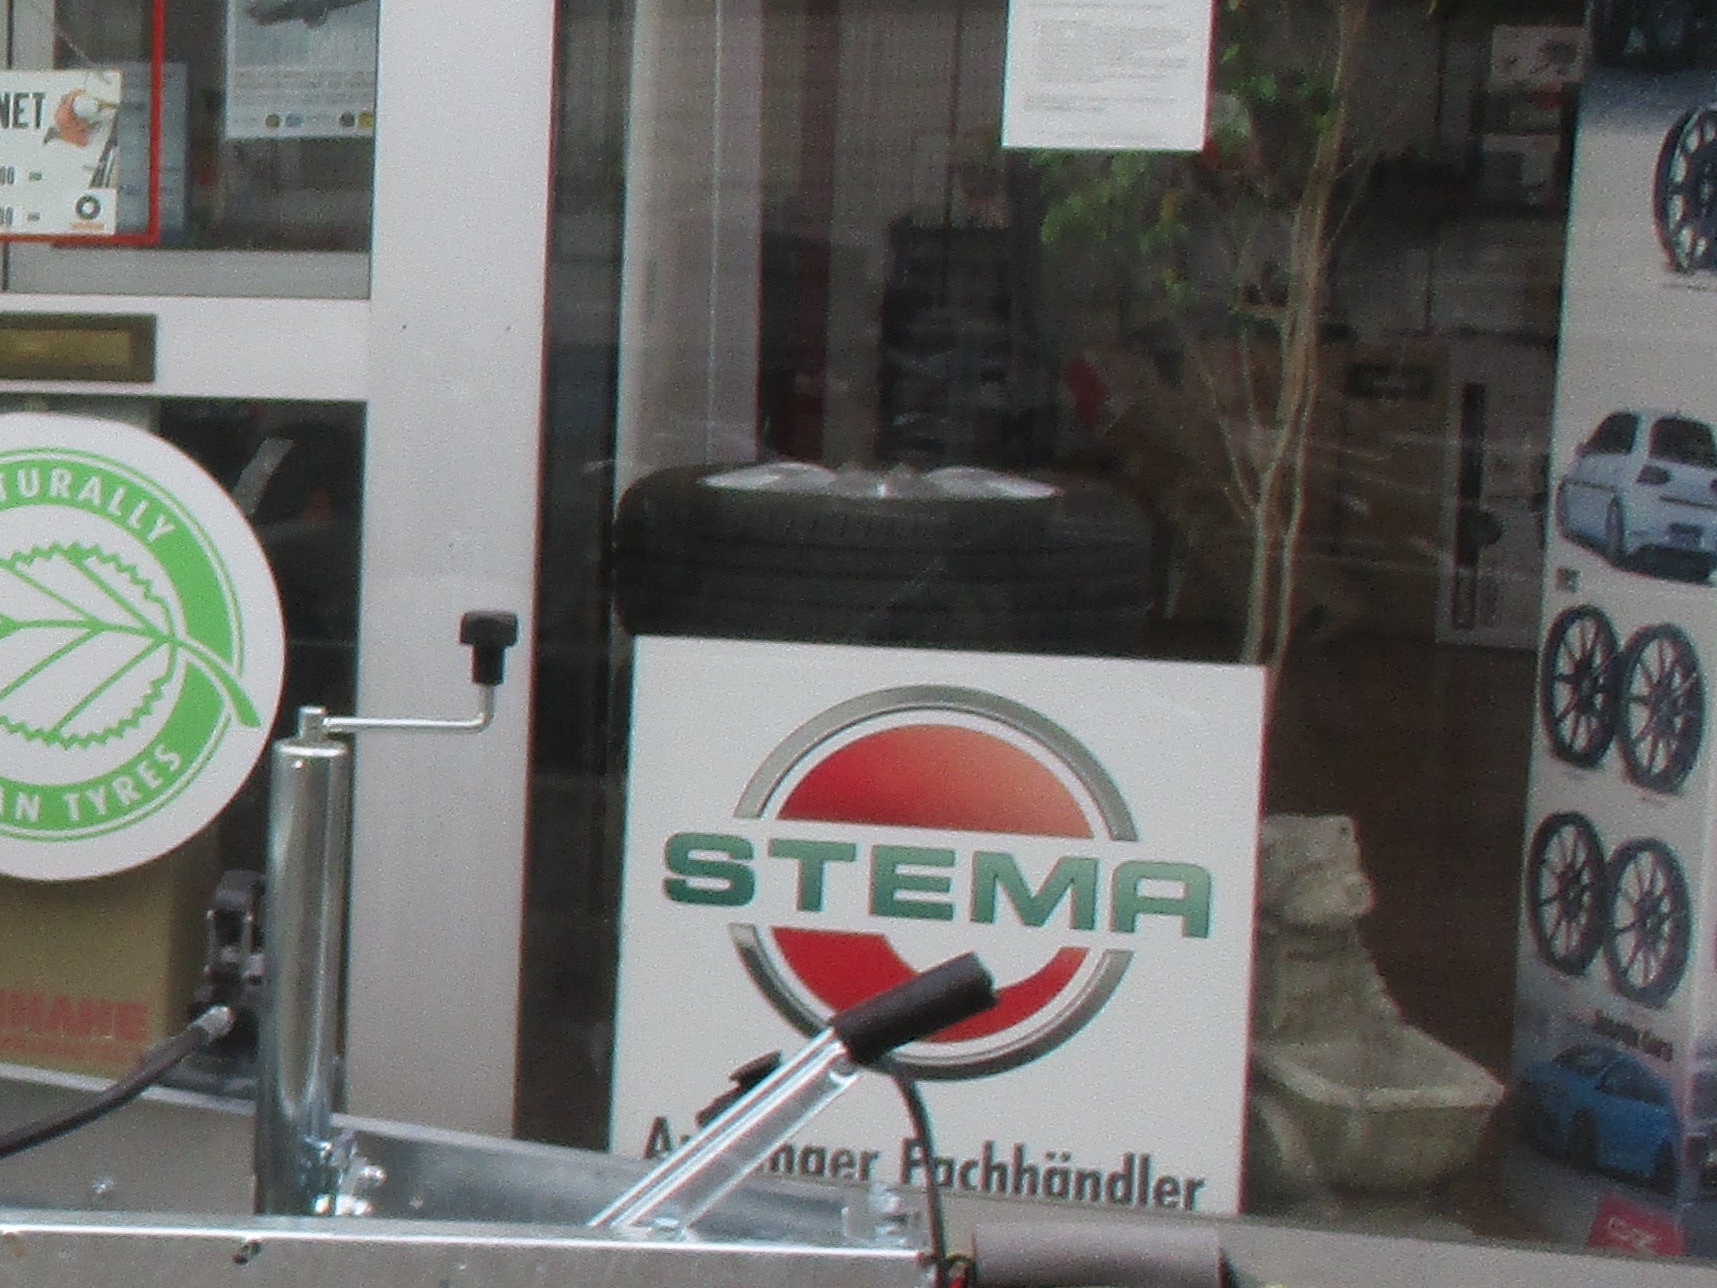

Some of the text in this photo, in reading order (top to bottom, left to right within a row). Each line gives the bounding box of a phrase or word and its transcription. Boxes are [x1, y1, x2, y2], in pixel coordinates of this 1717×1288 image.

[63, 743, 182, 821] TYRES
[662, 831, 1214, 940] STEMA
[897, 1136, 1207, 1212] Fachhändler
